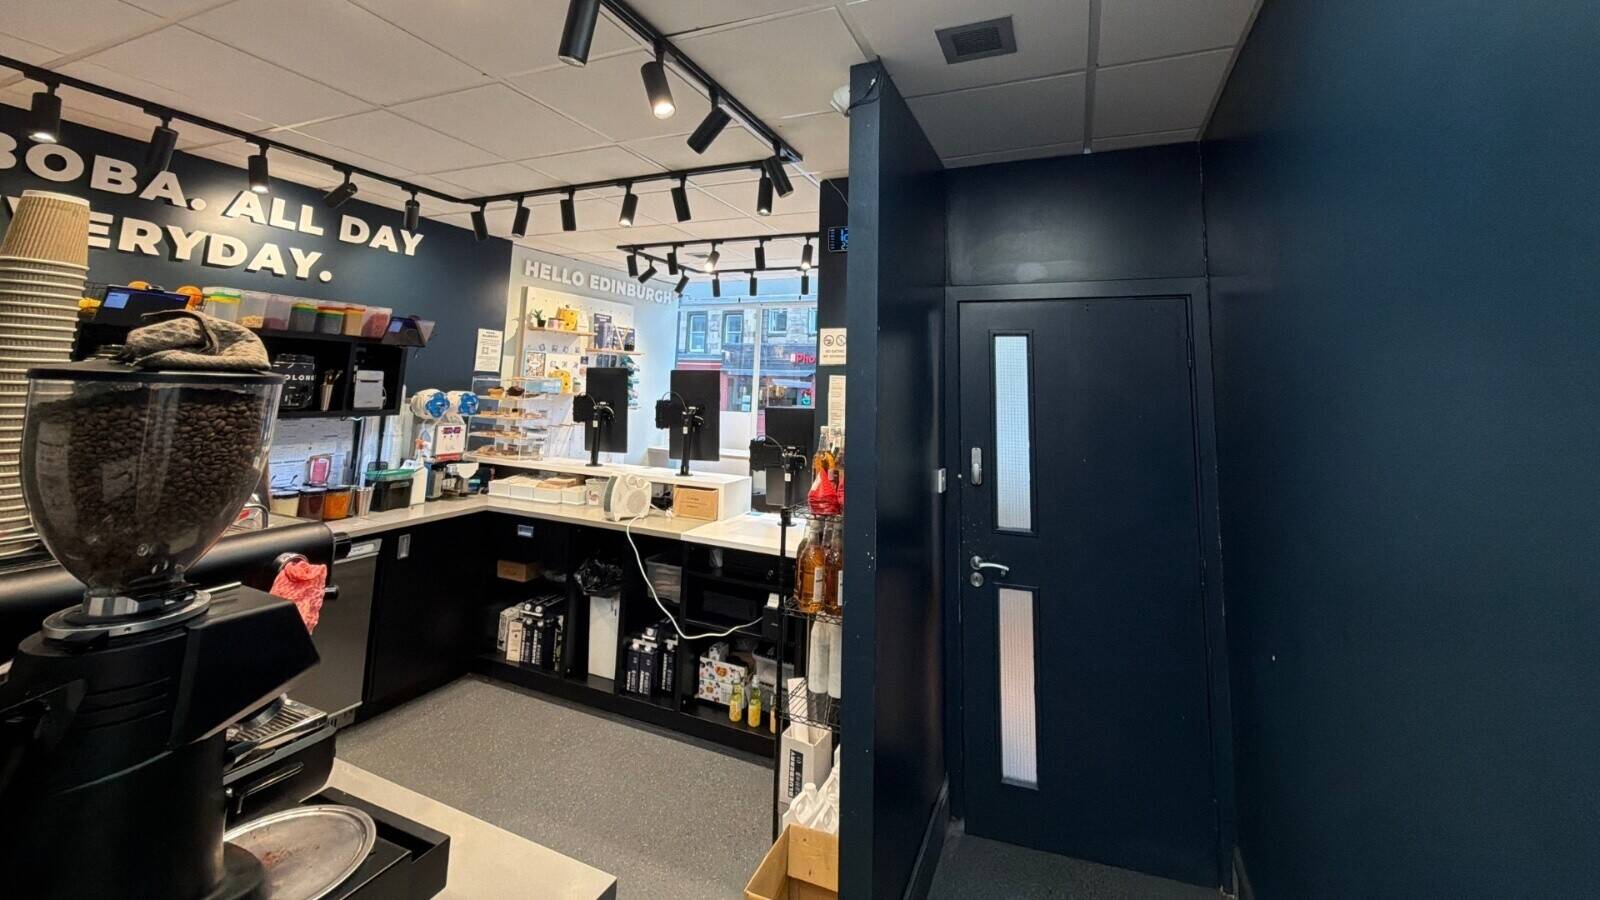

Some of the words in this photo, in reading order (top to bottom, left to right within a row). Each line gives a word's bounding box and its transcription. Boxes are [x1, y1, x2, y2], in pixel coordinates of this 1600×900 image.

[7, 196, 332, 283] ERYDAY.
[225, 191, 324, 236] ALL
[339, 215, 424, 256] DAY
[525, 260, 585, 287] HELLO
[590, 274, 672, 304] EDINBURGH
